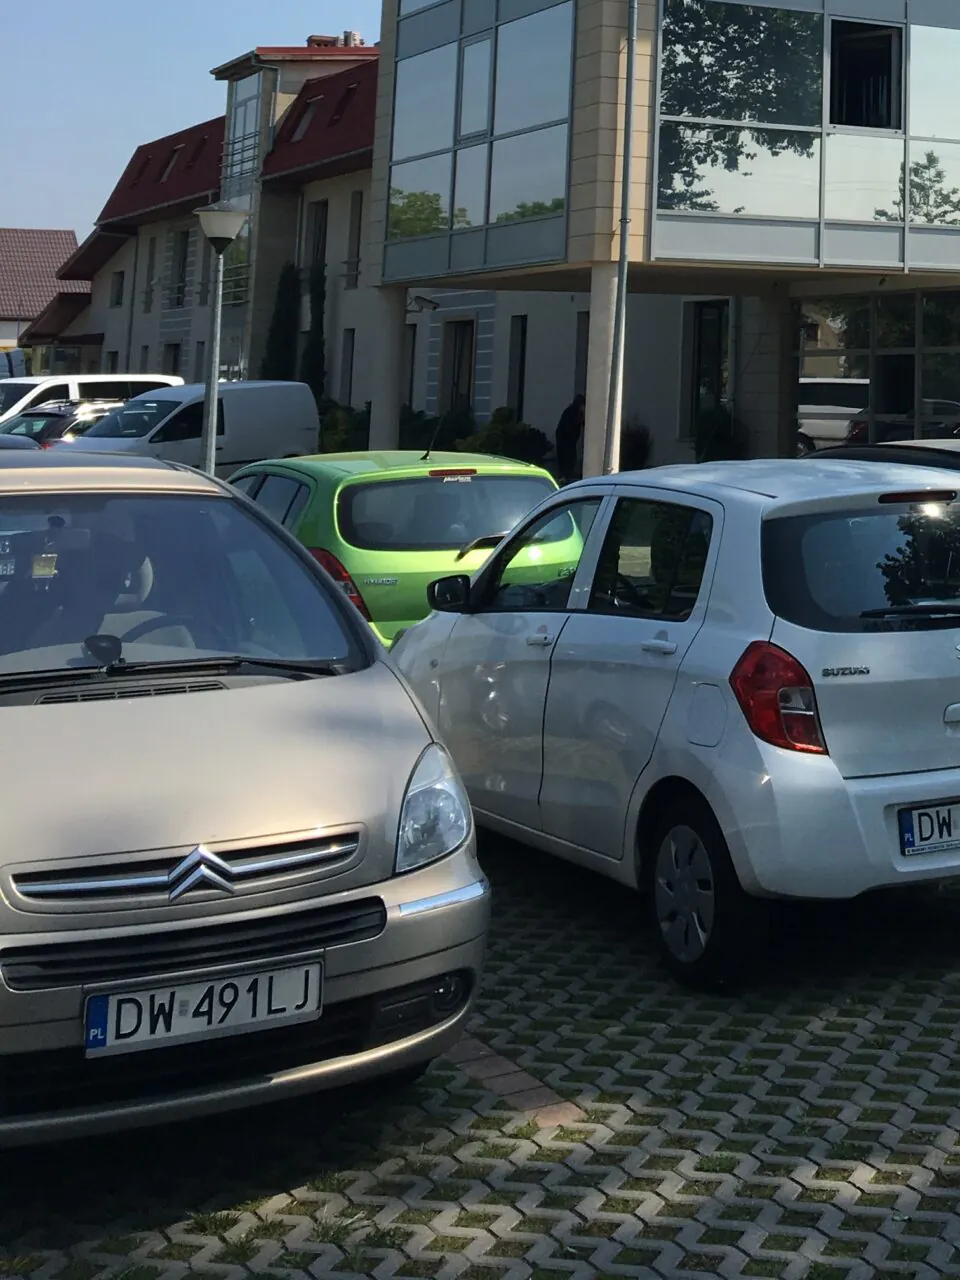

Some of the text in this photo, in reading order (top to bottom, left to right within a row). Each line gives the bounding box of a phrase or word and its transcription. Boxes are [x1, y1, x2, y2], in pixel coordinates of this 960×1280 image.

[822, 666, 870, 677] SUZUKI
[918, 808, 952, 842] DW
[114, 969, 310, 1040] DW 491LJ
[89, 1027, 104, 1040] PL
